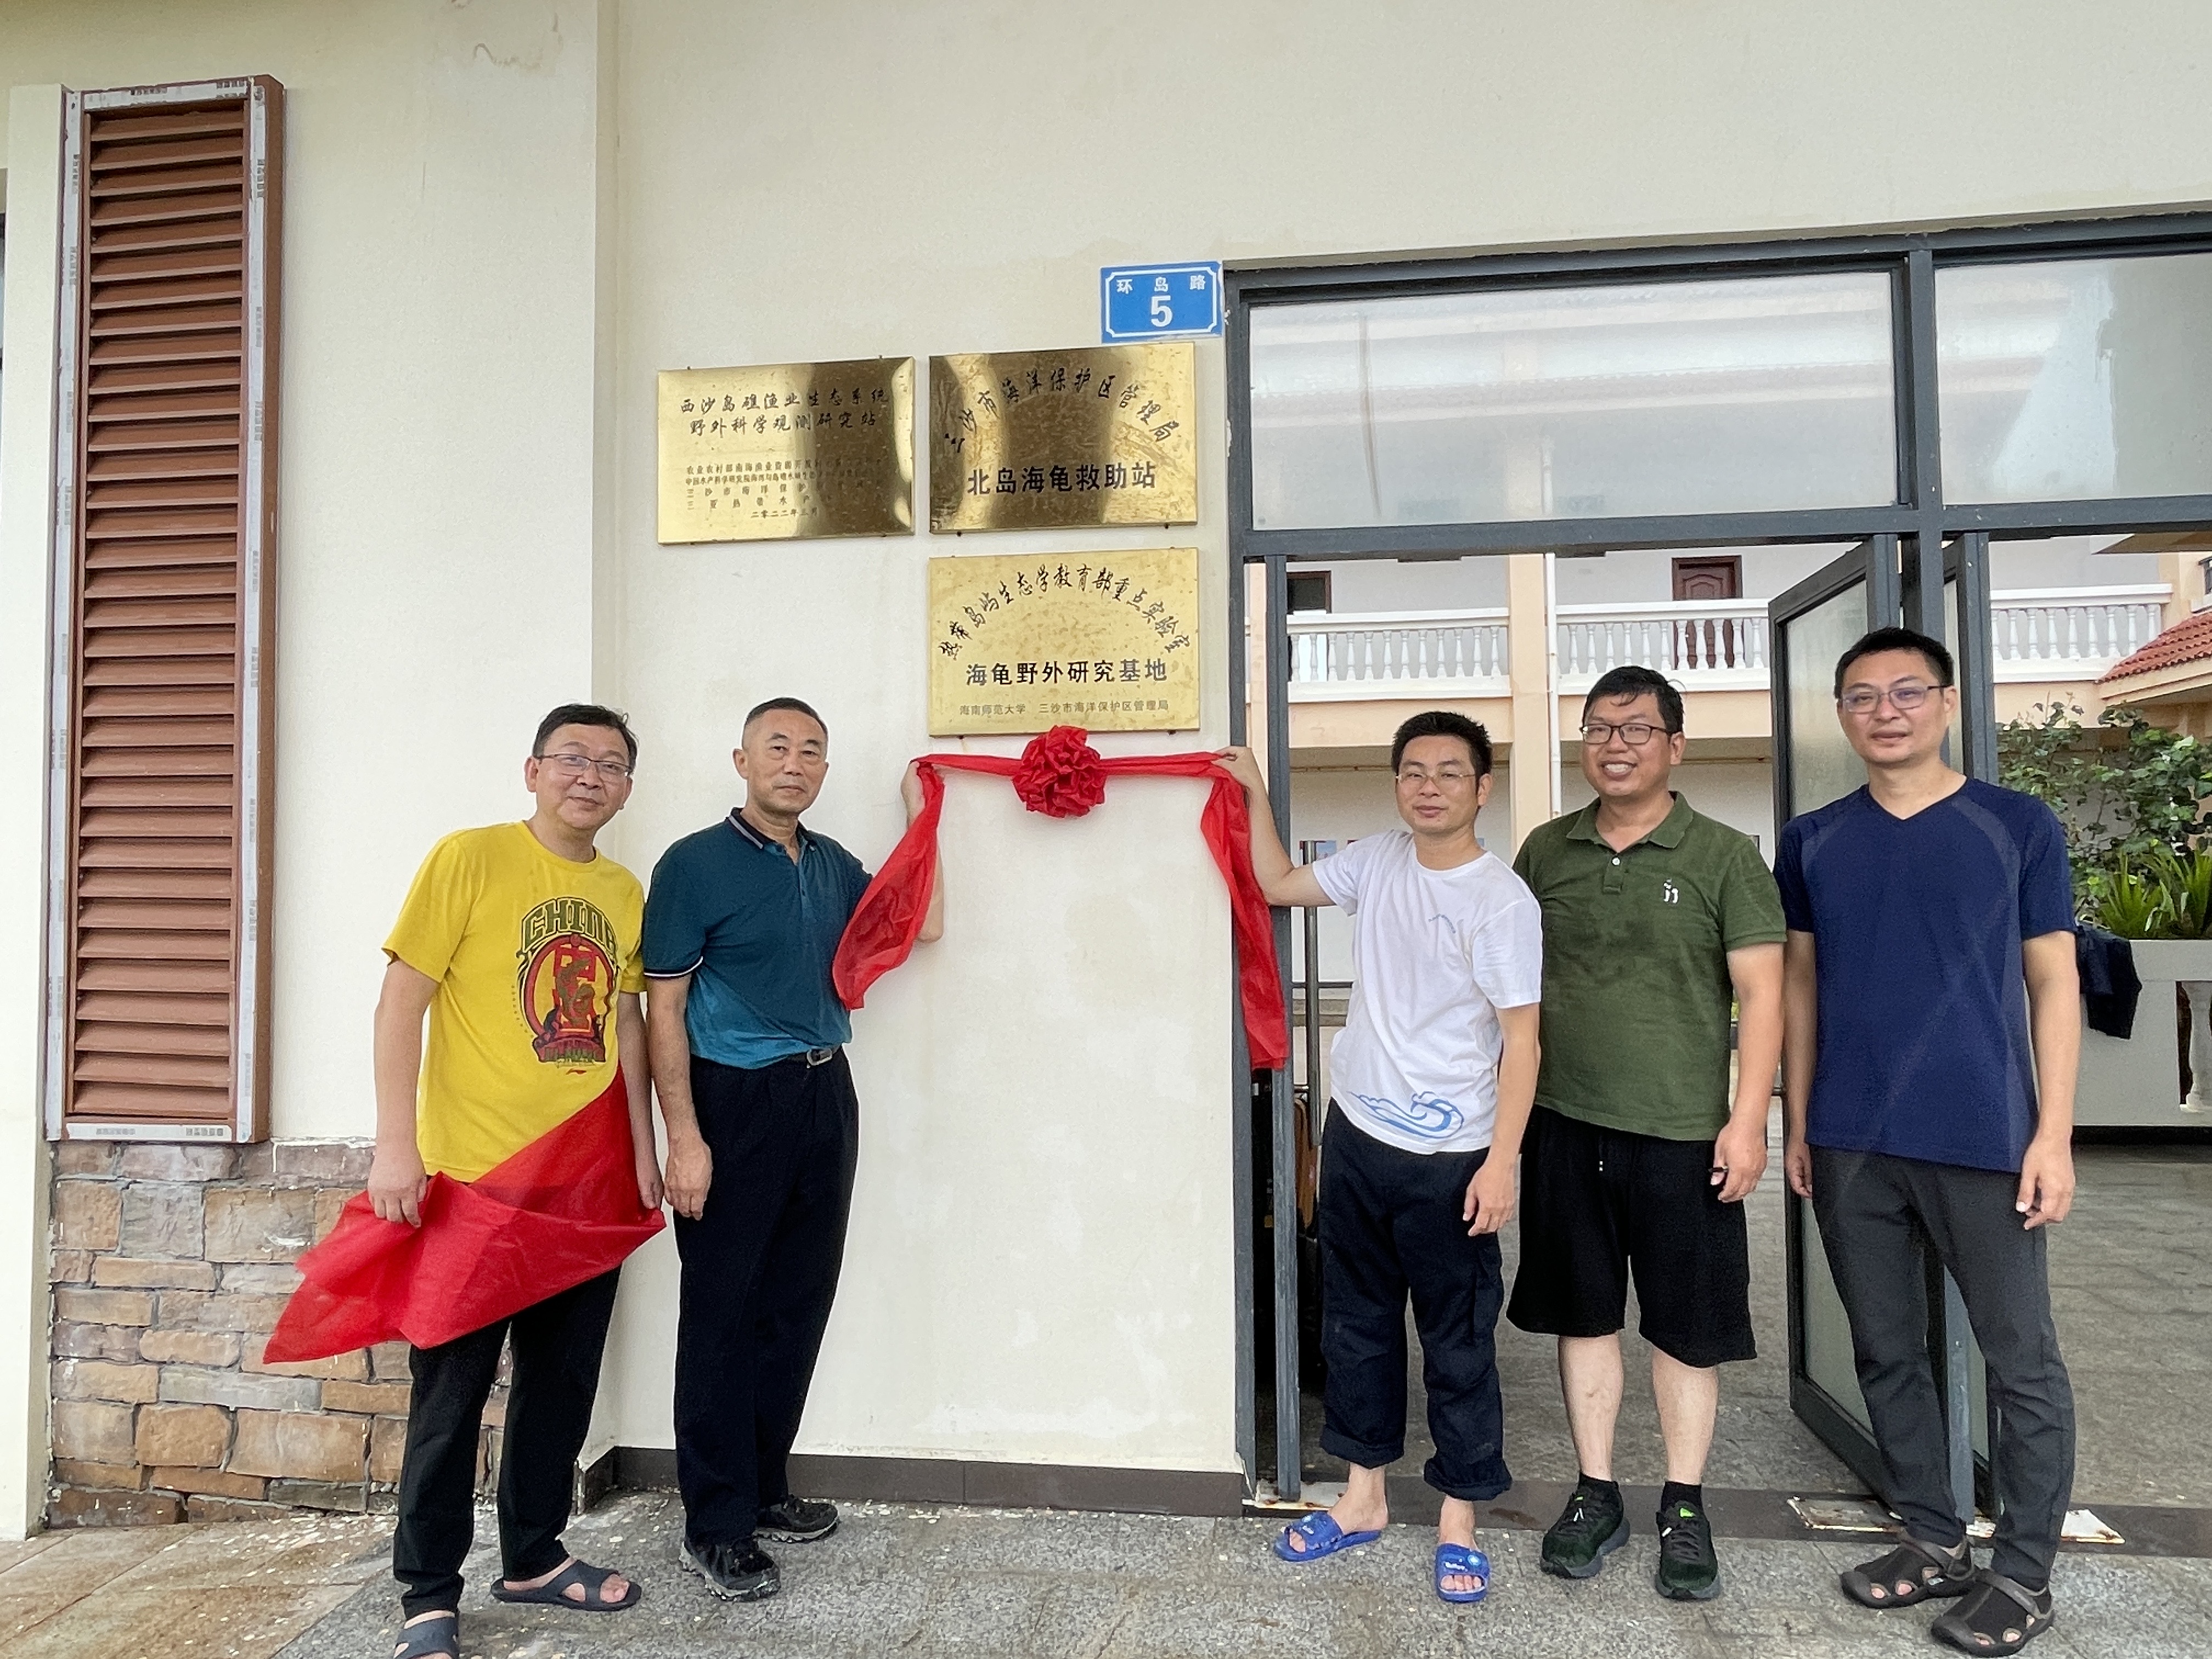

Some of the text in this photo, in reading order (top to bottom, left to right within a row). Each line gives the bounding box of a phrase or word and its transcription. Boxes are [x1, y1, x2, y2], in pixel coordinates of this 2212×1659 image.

[1116, 274, 1206, 295] 环岛路
[1150, 295, 1173, 328] 5
[680, 386, 890, 415] 西沙岛礁渔业生态系统
[690, 410, 878, 438] 野外科学观测研究站
[967, 461, 1156, 496] 北岛海龟救助站
[966, 658, 1168, 686] 海龟野外研究基地
[960, 701, 1169, 716] 海南师范大学 三沙市海洋保护区管理局
